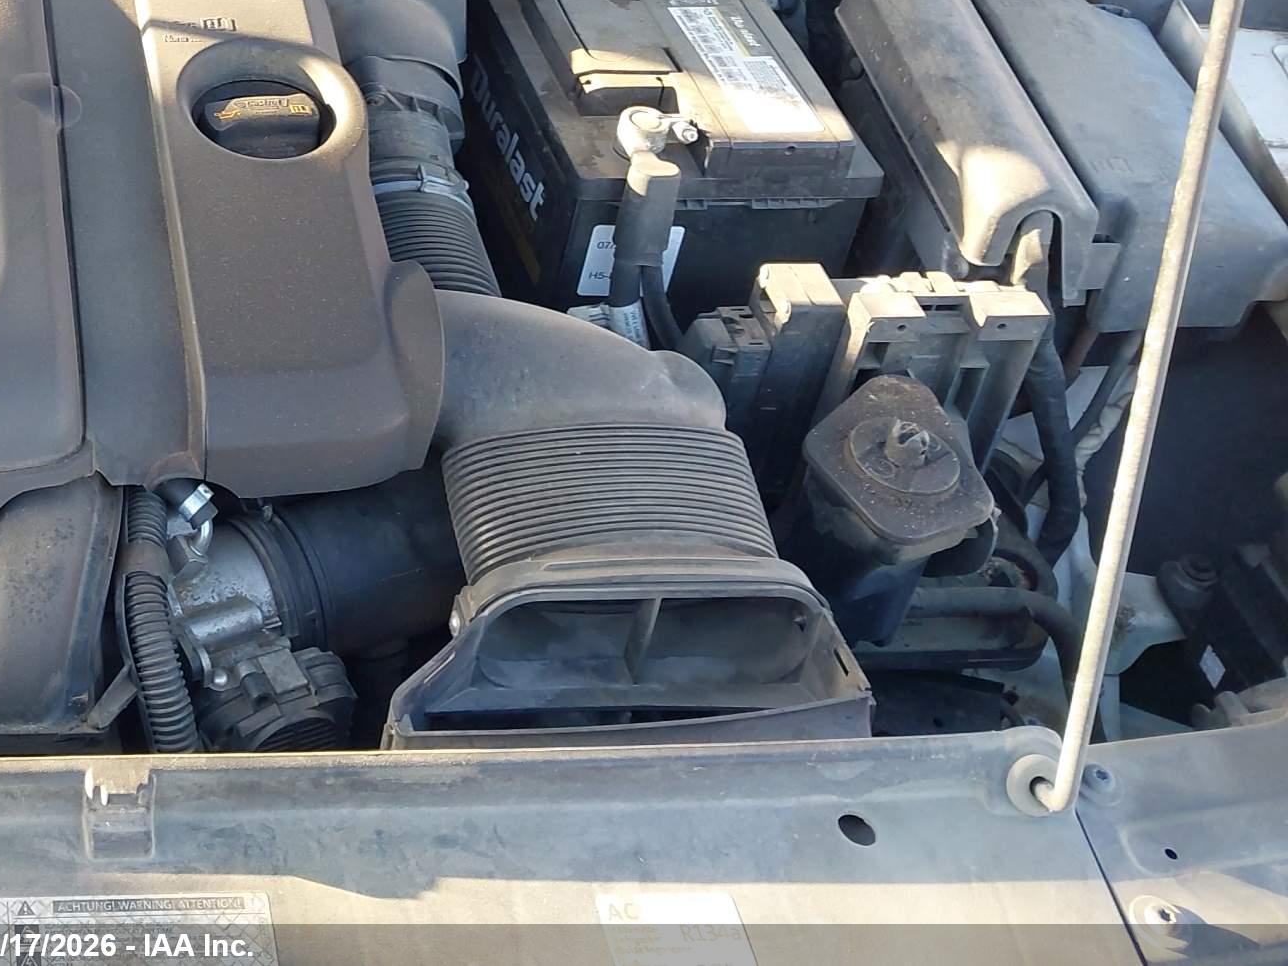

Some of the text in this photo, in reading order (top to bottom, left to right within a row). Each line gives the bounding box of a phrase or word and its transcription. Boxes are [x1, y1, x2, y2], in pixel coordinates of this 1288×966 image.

[58, 898, 241, 912] ACHTUNG! WARNING! ATTENTION!
[608, 902, 640, 921] AC
